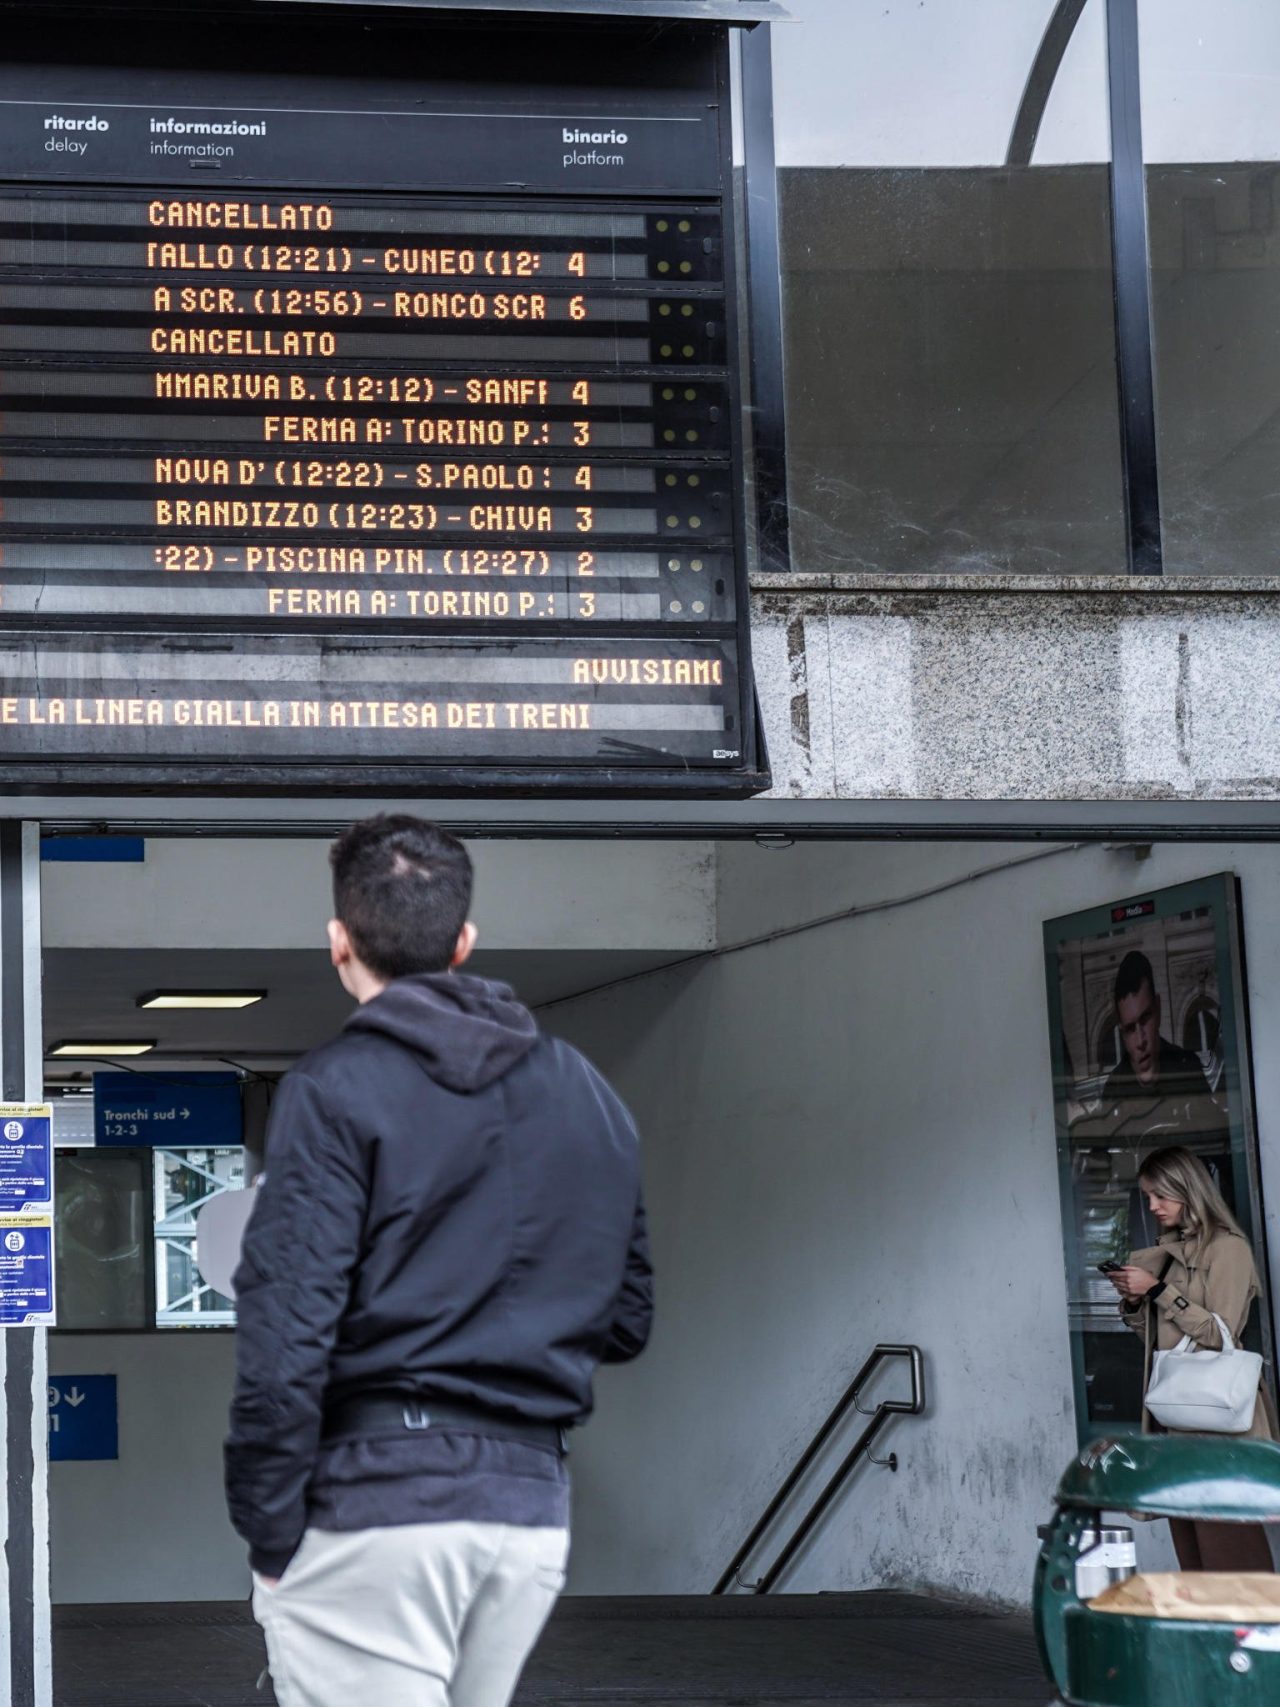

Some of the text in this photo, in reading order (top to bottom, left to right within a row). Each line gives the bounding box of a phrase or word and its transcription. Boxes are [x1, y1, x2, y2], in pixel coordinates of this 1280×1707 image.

[43, 114, 109, 132] ritardo
[149, 117, 267, 136] informazioni
[562, 127, 629, 145] binario
[44, 136, 88, 156] delay
[150, 139, 234, 157] information
[563, 149, 624, 168] platform
[149, 200, 332, 231] CANCELLATO
[244, 245, 352, 273] (12:21)
[384, 248, 475, 275] CUNEO
[484, 250, 540, 276] (12:
[568, 252, 585, 277] 4
[154, 286, 171, 313] A
[181, 287, 244, 314] SCR.
[254, 289, 362, 316] (12:56)
[395, 292, 486, 319] RONCO
[493, 293, 545, 320] SCR
[569, 295, 586, 320] 6
[151, 327, 336, 356] CANCELLATO
[156, 372, 280, 400] MMARIVA
[290, 375, 317, 400] B.
[325, 376, 434, 402] (12:12)
[572, 380, 588, 405] 4
[264, 415, 356, 443] FERMA
[366, 418, 393, 443] A:
[402, 418, 504, 446] TORINO
[573, 421, 590, 447] 3
[156, 457, 229, 485] NOVA
[239, 460, 265, 485] D'
[274, 460, 384, 487] (12:22)
[416, 462, 533, 490] S.PAOLO
[575, 465, 591, 491] 4
[156, 499, 319, 528] BRANDIZZO
[329, 502, 437, 530] (12:23)
[469, 505, 552, 532] CHIVA
[576, 507, 593, 532] 3
[155, 544, 214, 572] :22)
[246, 546, 366, 574] PISCINA
[375, 548, 433, 574] PIN.
[443, 550, 550, 576] (12:27)
[578, 551, 594, 577] 2
[268, 588, 360, 614] FERMA
[371, 590, 396, 615] A:
[406, 591, 509, 617] TORINO
[579, 592, 595, 617] 3
[28, 698, 65, 724] LA
[75, 699, 163, 725] LINEA
[173, 700, 280, 727] GIALLA
[290, 702, 321, 727] IN
[330, 702, 438, 728] ATTESA
[447, 704, 496, 729] DEI
[506, 704, 590, 730] TRENI
[104, 1108, 176, 1121] Tronchi sud
[104, 1124, 139, 1136] 1-2-3
